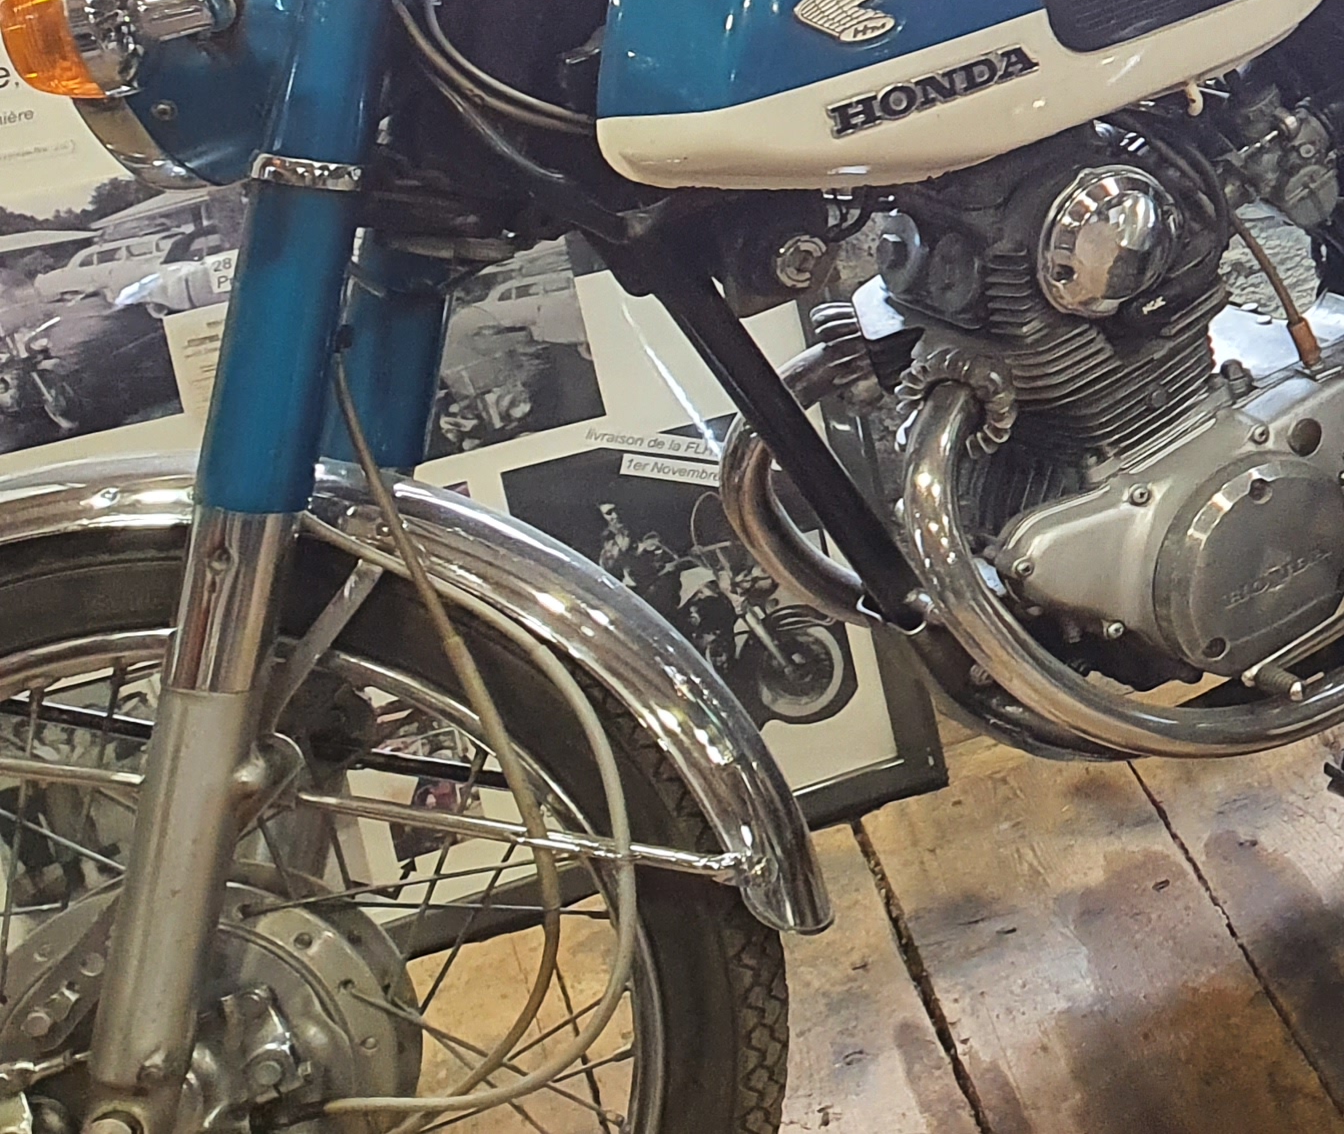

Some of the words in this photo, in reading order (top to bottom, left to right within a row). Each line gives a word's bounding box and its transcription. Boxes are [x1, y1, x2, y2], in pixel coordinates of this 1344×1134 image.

[828, 44, 1040, 137] HONDA
[211, 257, 232, 273] 28
[585, 428, 644, 448] livraison
[647, 438, 665, 450] de
[668, 439, 682, 452] la
[626, 458, 648, 470] 1er
